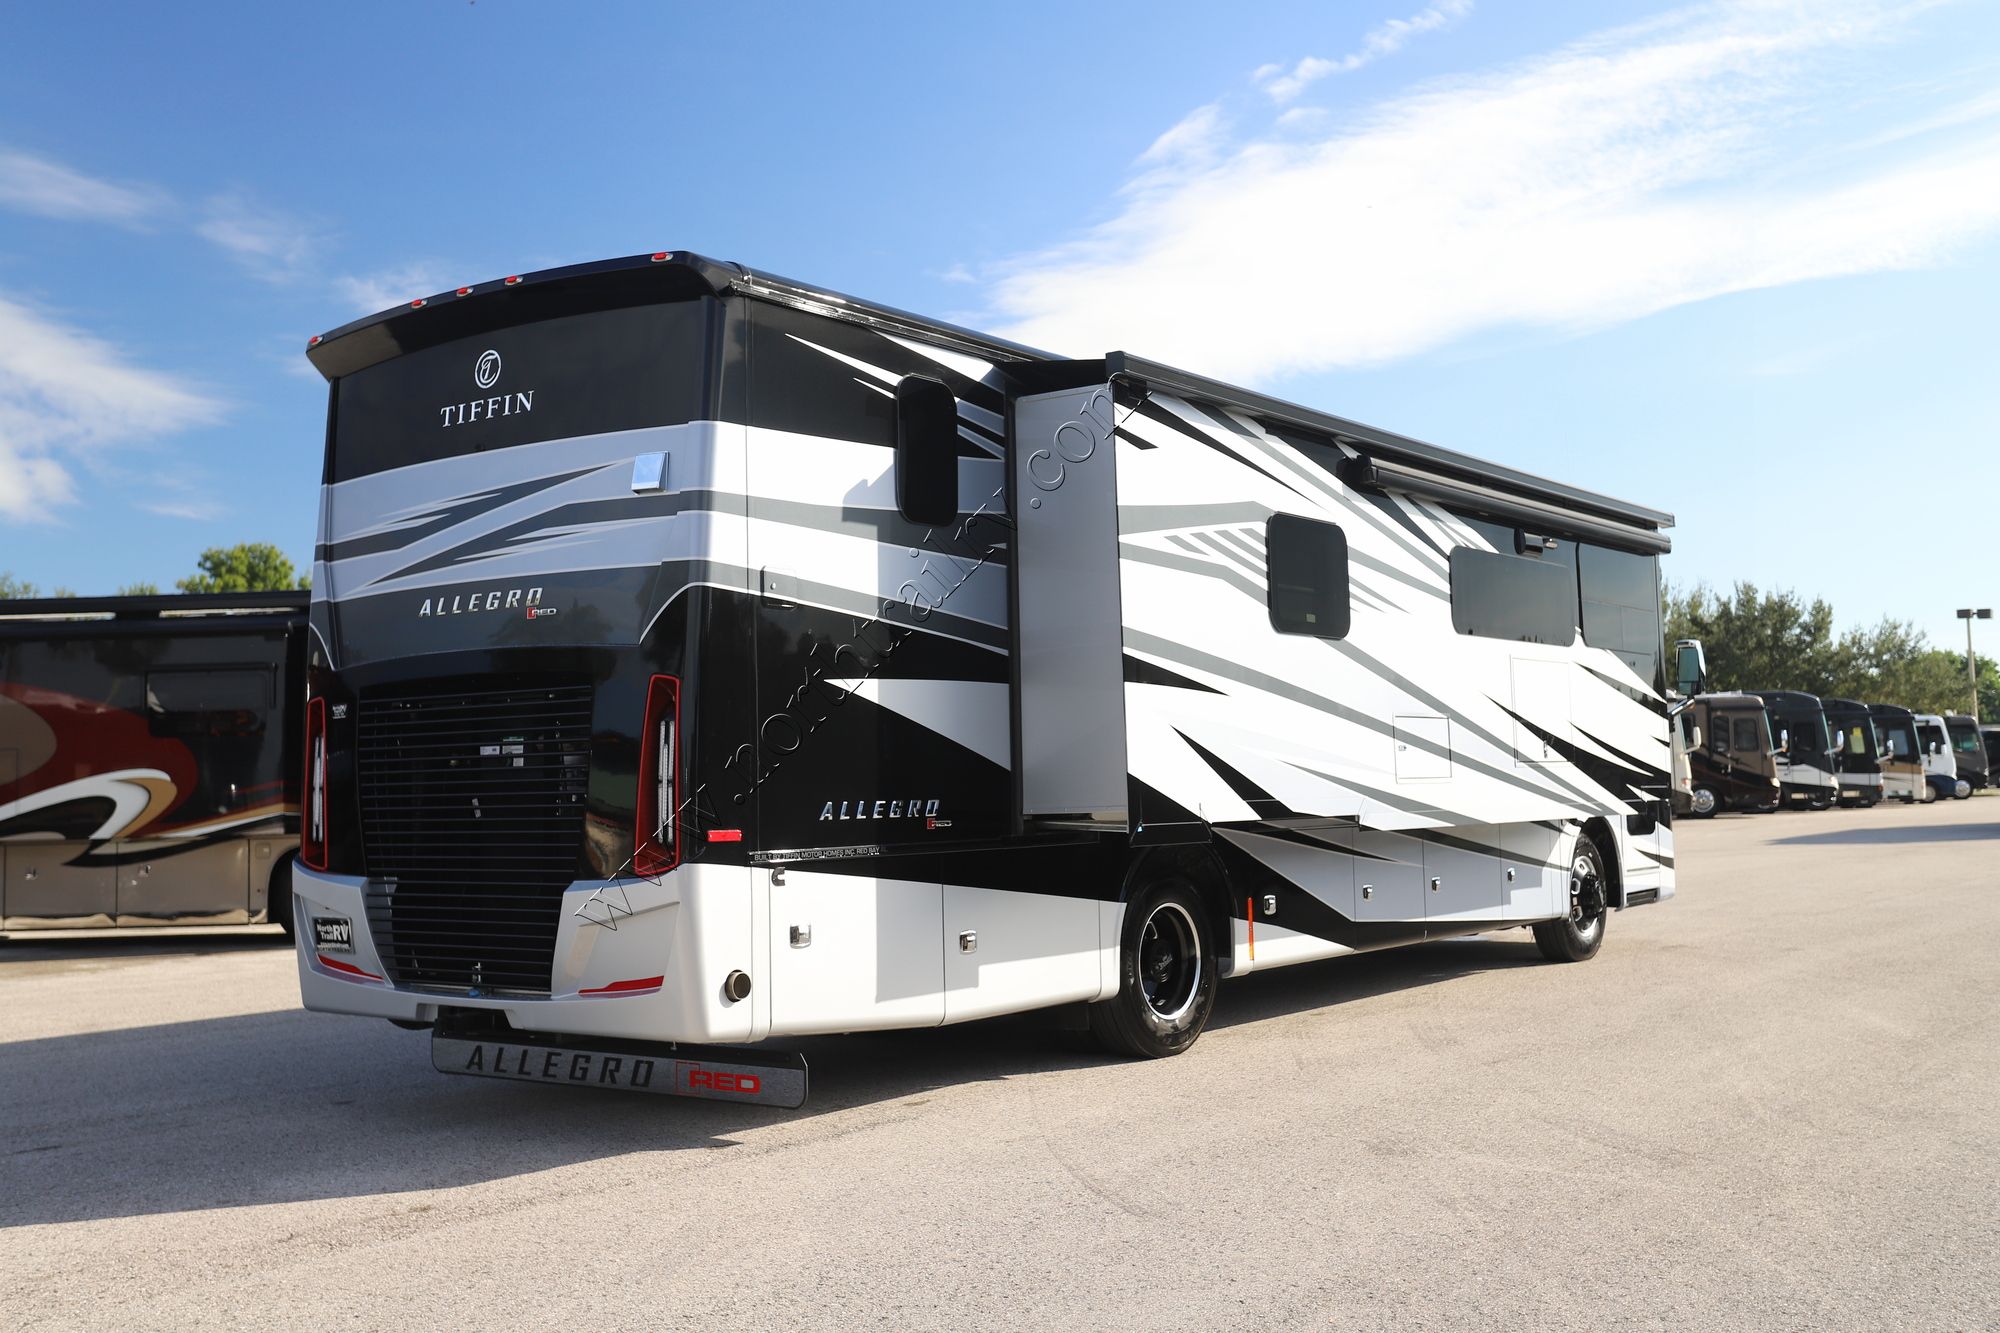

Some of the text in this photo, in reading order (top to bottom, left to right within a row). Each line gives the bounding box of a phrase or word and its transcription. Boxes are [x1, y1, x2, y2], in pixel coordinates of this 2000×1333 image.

[440, 390, 535, 427] TIFFIN
[418, 587, 543, 617] ALLEGRO
[531, 607, 557, 617] RED
[819, 799, 940, 821] ALLEGRO
[754, 853, 771, 861] BUILT
[801, 850, 822, 858] MOTOR
[823, 849, 844, 857] HOMES
[332, 924, 349, 941] RV
[465, 1045, 655, 1088] ALLEGRO
[688, 1069, 761, 1093] RED
